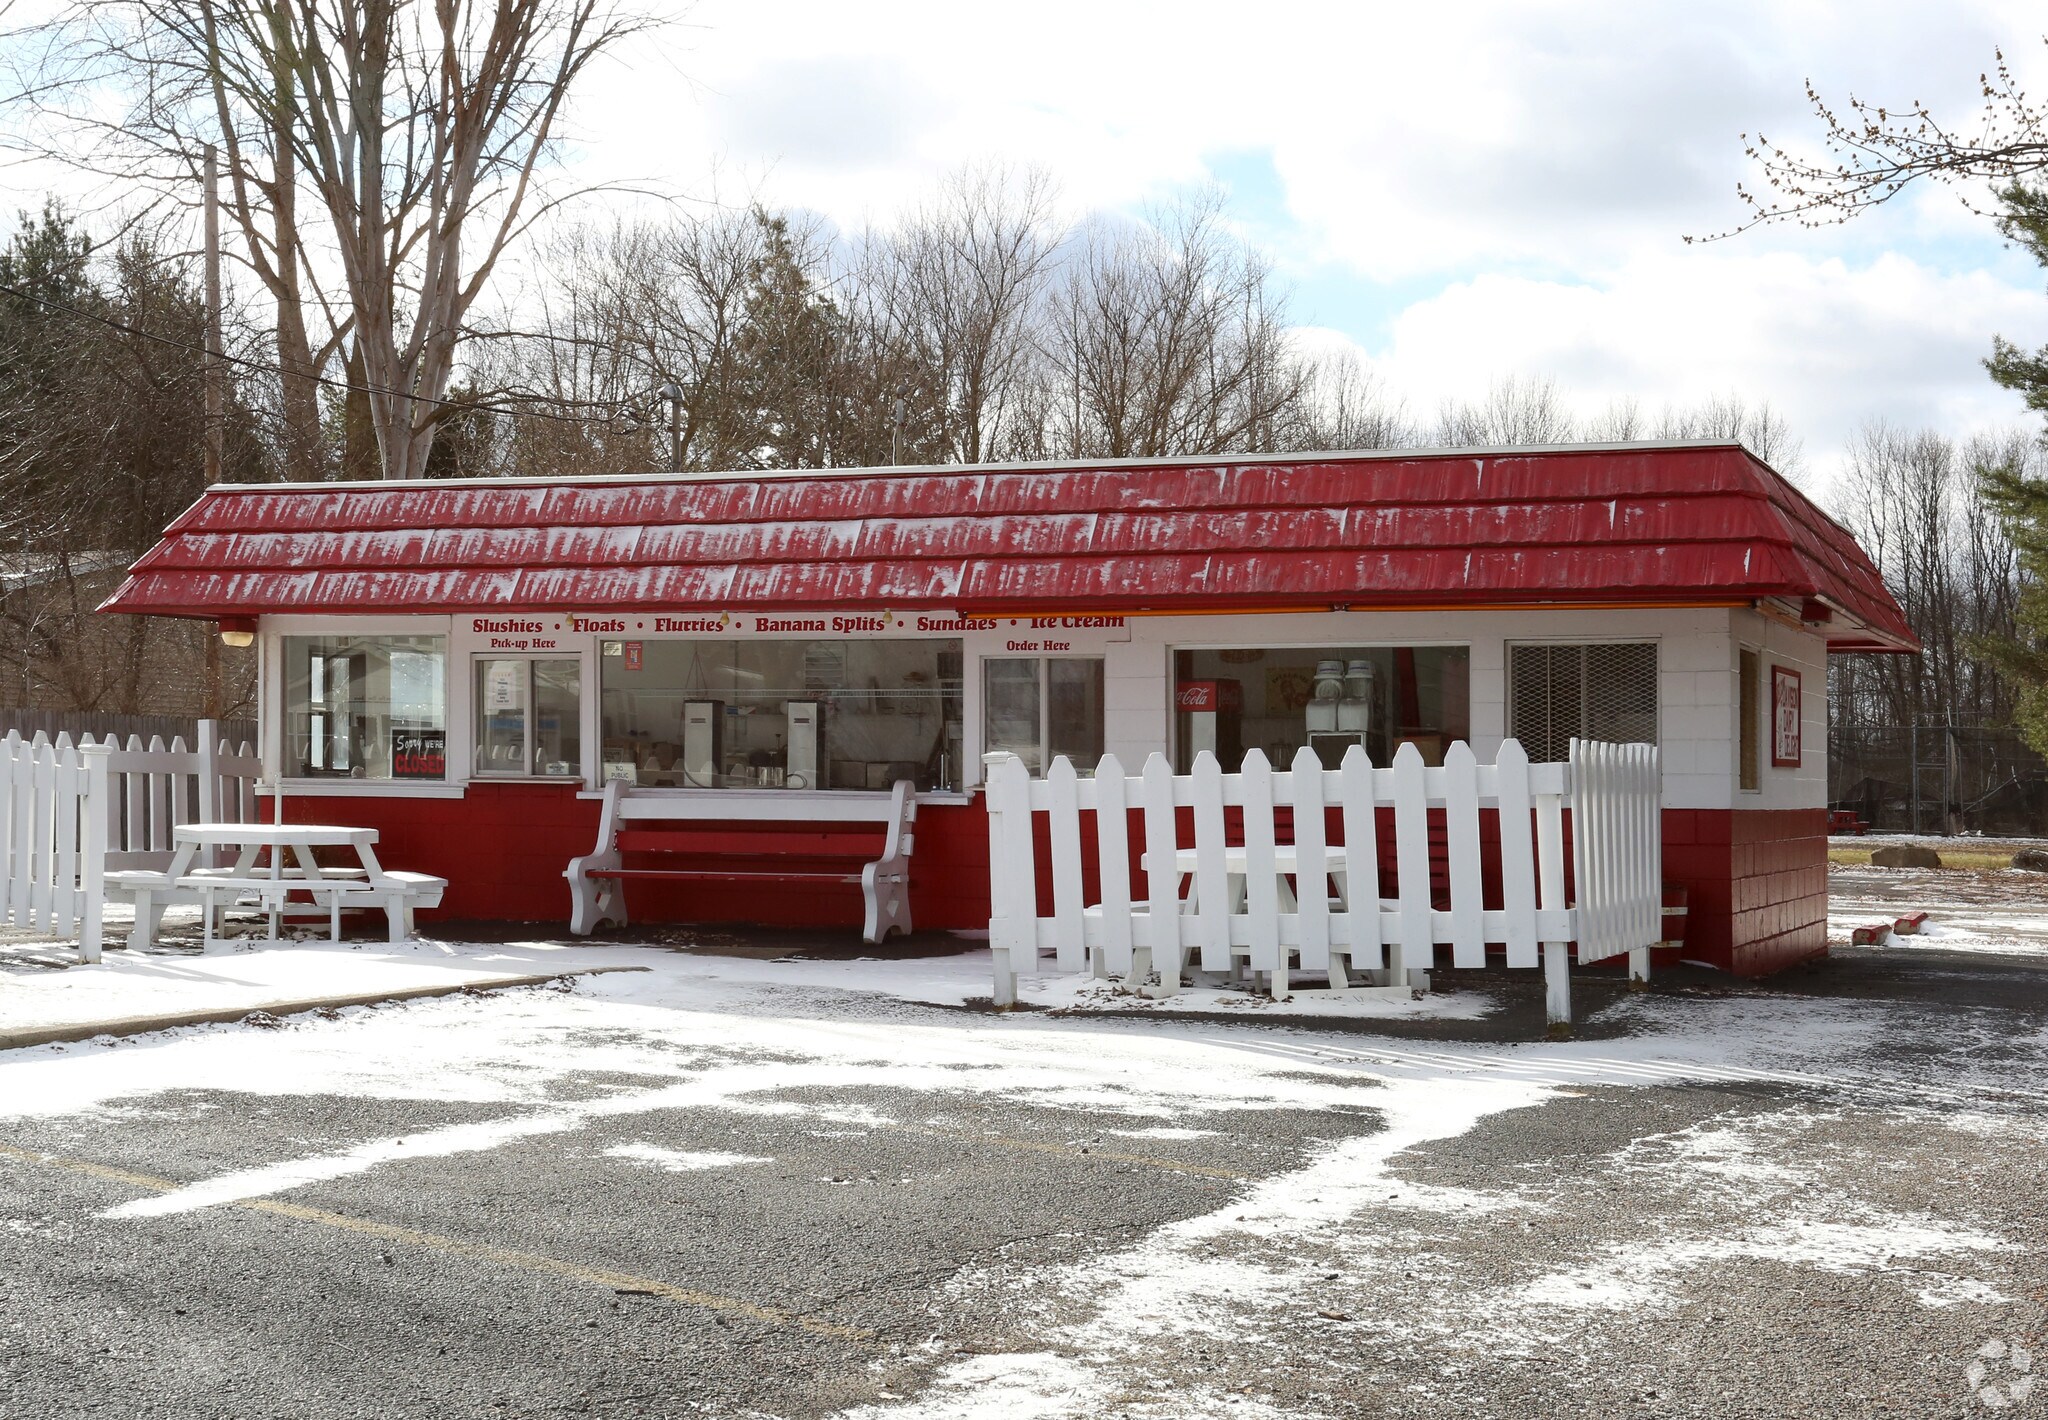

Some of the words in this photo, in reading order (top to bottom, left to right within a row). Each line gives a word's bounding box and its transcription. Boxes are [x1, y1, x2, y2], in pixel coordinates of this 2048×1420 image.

[472, 618, 543, 633] Slushies
[572, 618, 625, 633] Floats
[654, 617, 724, 632] Flurries
[755, 617, 826, 632] Banana
[832, 616, 885, 634] Splits
[917, 616, 997, 631] Sundaes
[1030, 617, 1057, 629] Ice
[1061, 616, 1125, 628] Cream
[490, 638, 528, 650] Pick-up
[532, 638, 556, 648] Here
[1006, 640, 1039, 651] Order
[1043, 640, 1070, 651] Here
[396, 735, 422, 752] Sorry
[394, 753, 445, 773] CLOSED
